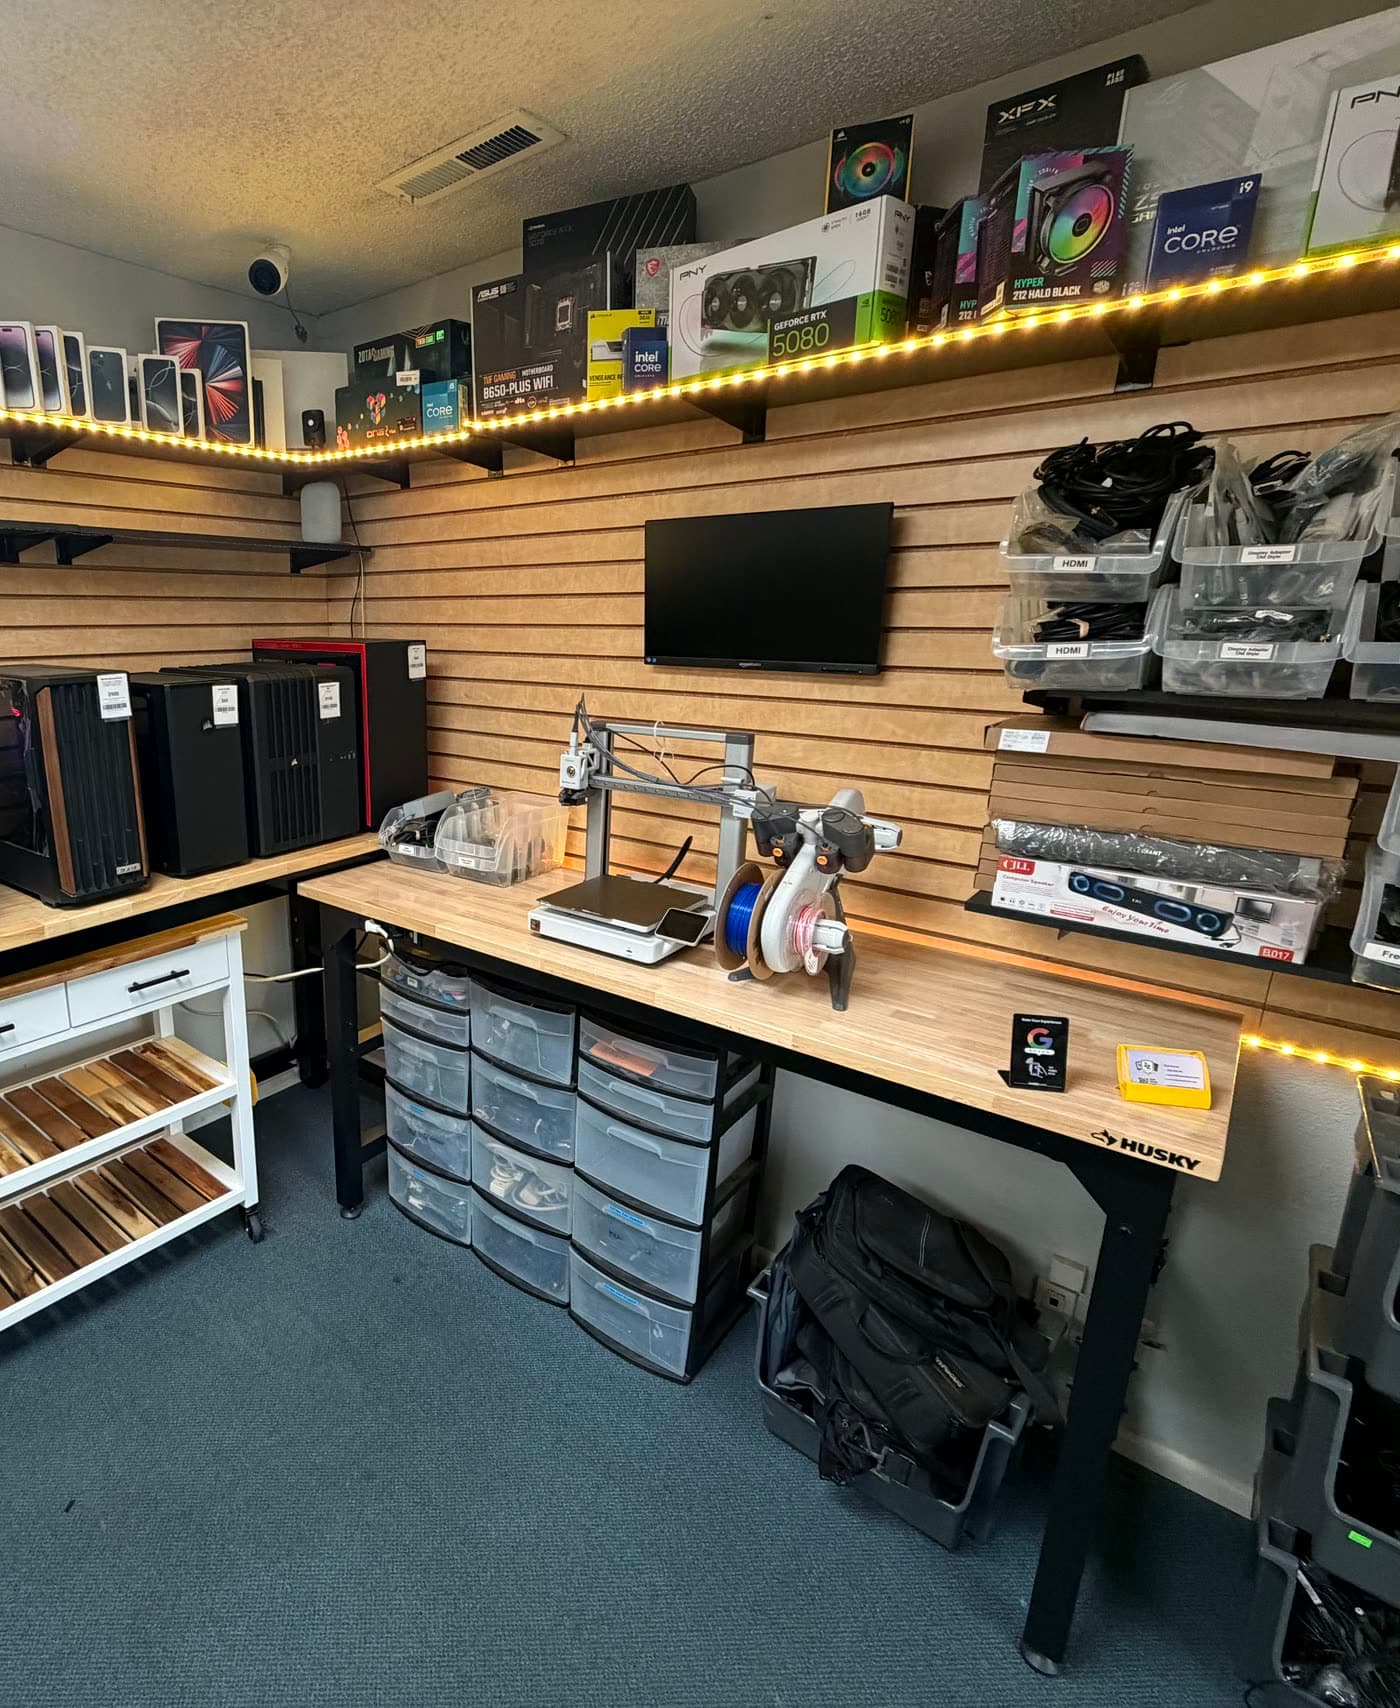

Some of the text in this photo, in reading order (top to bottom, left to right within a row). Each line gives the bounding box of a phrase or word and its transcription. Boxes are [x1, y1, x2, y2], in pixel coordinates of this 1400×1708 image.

[997, 94, 1057, 124] XFX
[1239, 181, 1254, 194] i9
[679, 265, 708, 281] PNY
[1014, 277, 1044, 289] HYPER
[1012, 285, 1081, 300] 212 HALO BLACK
[774, 309, 828, 331] GEFORCE RTX
[772, 322, 830, 357] 5080
[635, 351, 659, 362] intel
[483, 375, 554, 400] B650-PLUS WIFI
[1062, 559, 1089, 568] HDMI
[1055, 647, 1081, 655] HDMI
[1119, 1137, 1201, 1171] HUSKY
